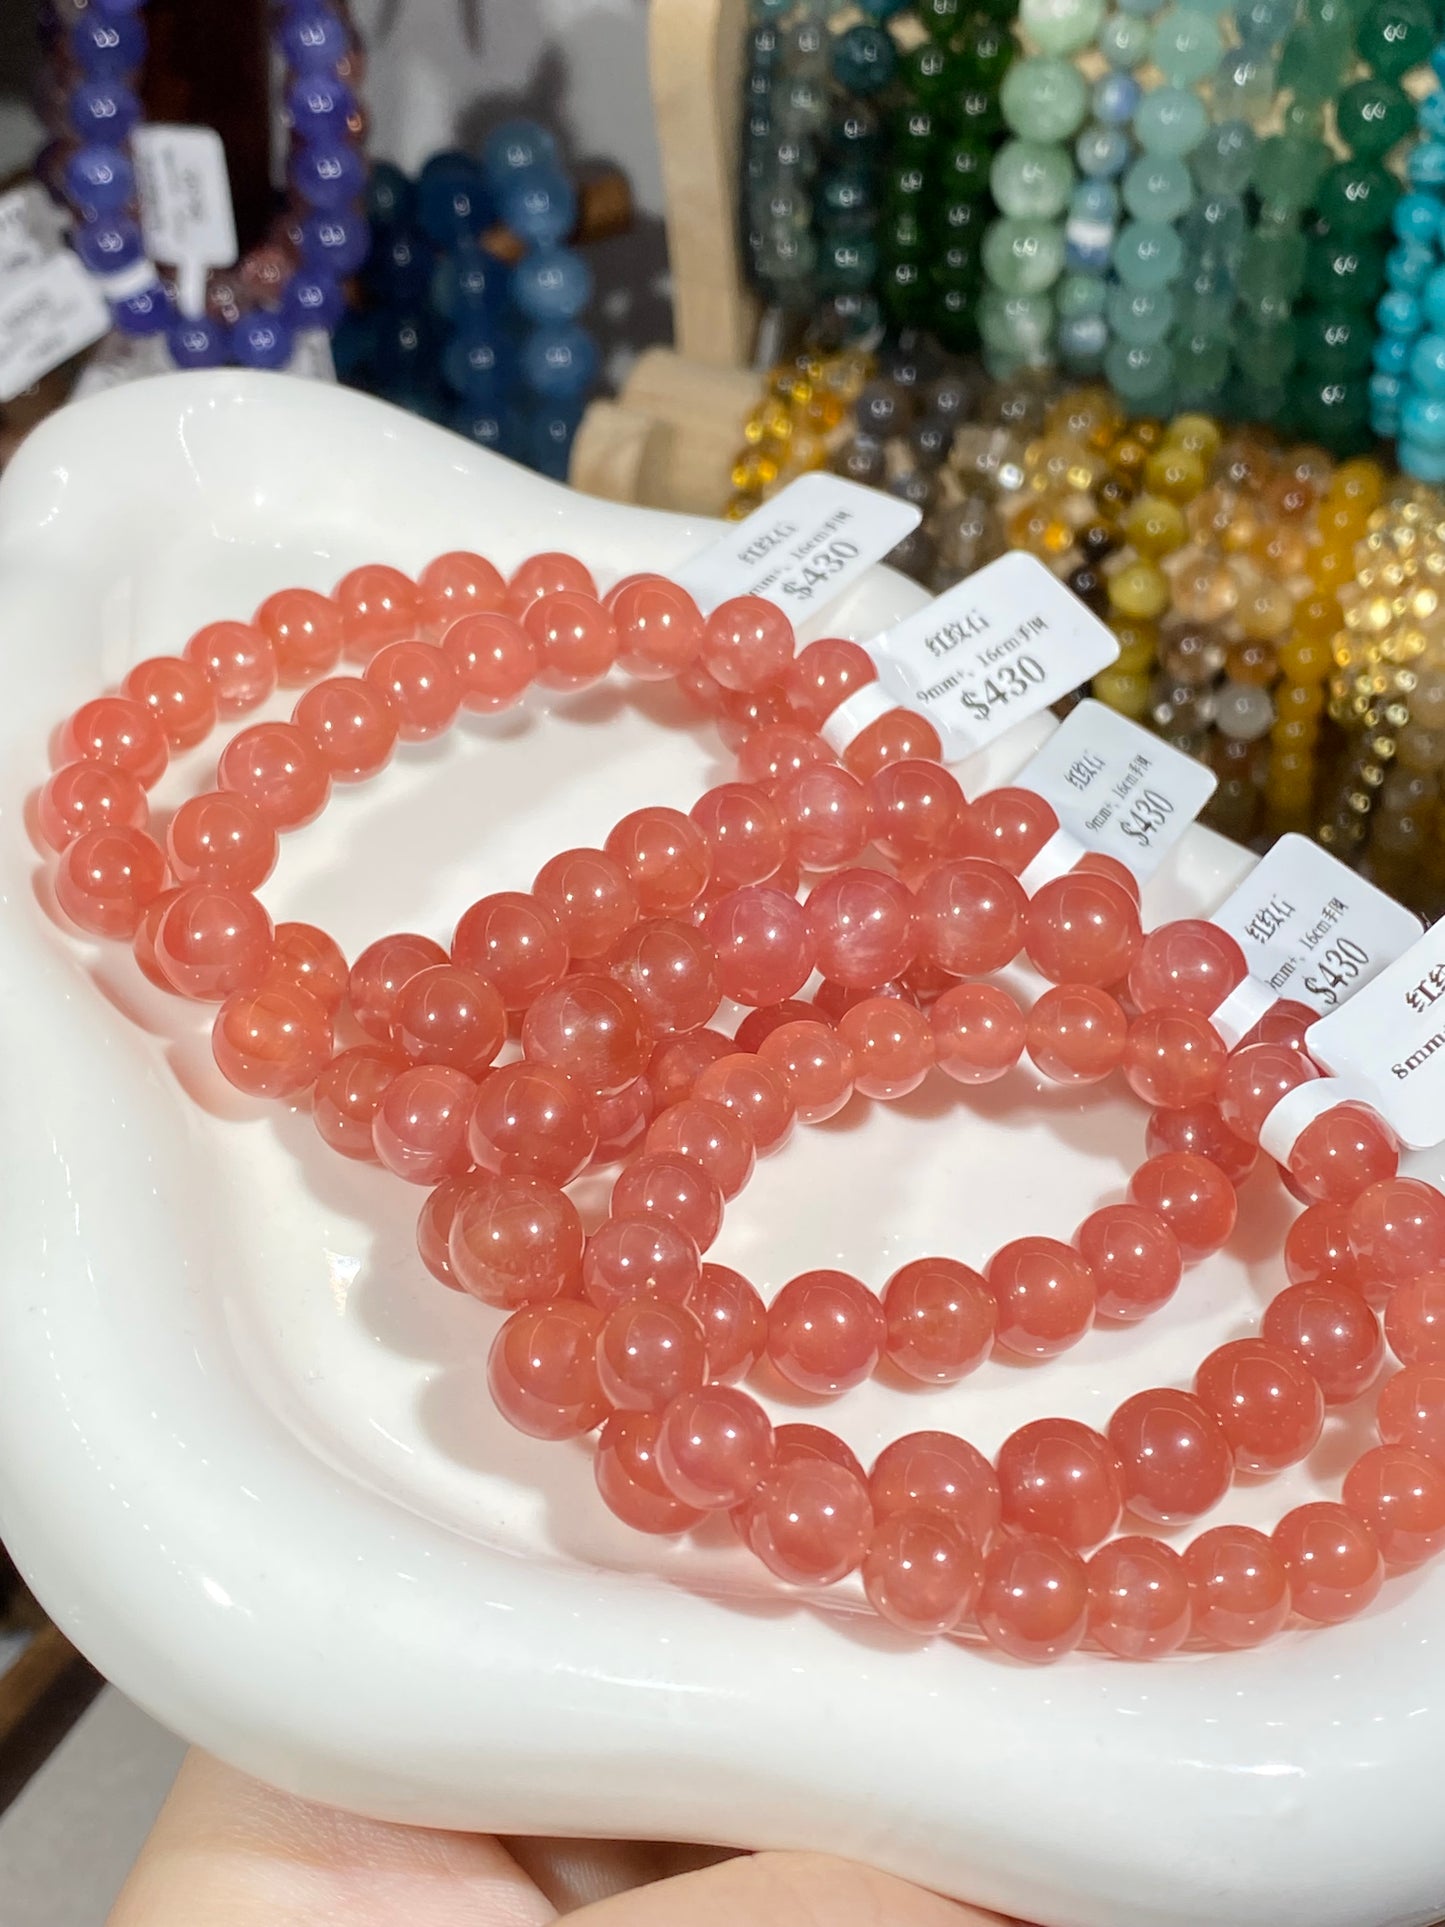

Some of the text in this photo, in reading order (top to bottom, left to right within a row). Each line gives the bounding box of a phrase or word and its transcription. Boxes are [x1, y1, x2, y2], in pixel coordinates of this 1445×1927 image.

[781, 541, 860, 602] $430
[960, 655, 1046, 721] $430
[1118, 789, 1174, 848] $430
[1302, 937, 1370, 1006] $430
[1391, 1024, 1445, 1080] 8mm
